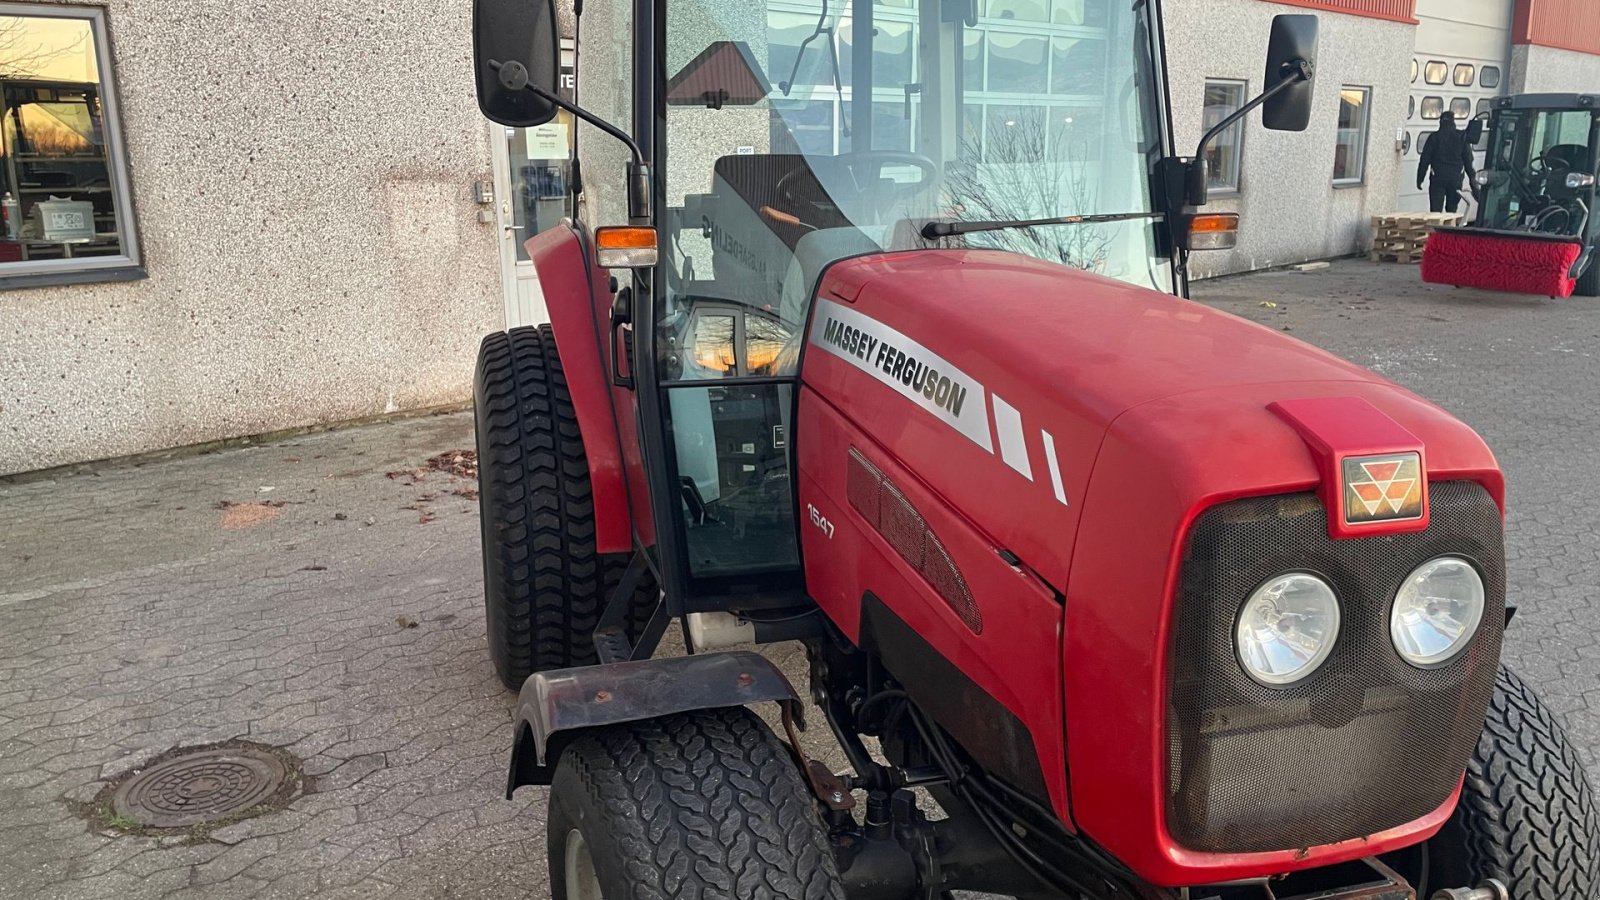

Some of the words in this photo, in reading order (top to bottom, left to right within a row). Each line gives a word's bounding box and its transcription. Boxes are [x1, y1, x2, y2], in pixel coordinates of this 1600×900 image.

[823, 317, 878, 362] MASSEY
[875, 342, 967, 418] FERGUSON
[807, 503, 835, 539] 1547
